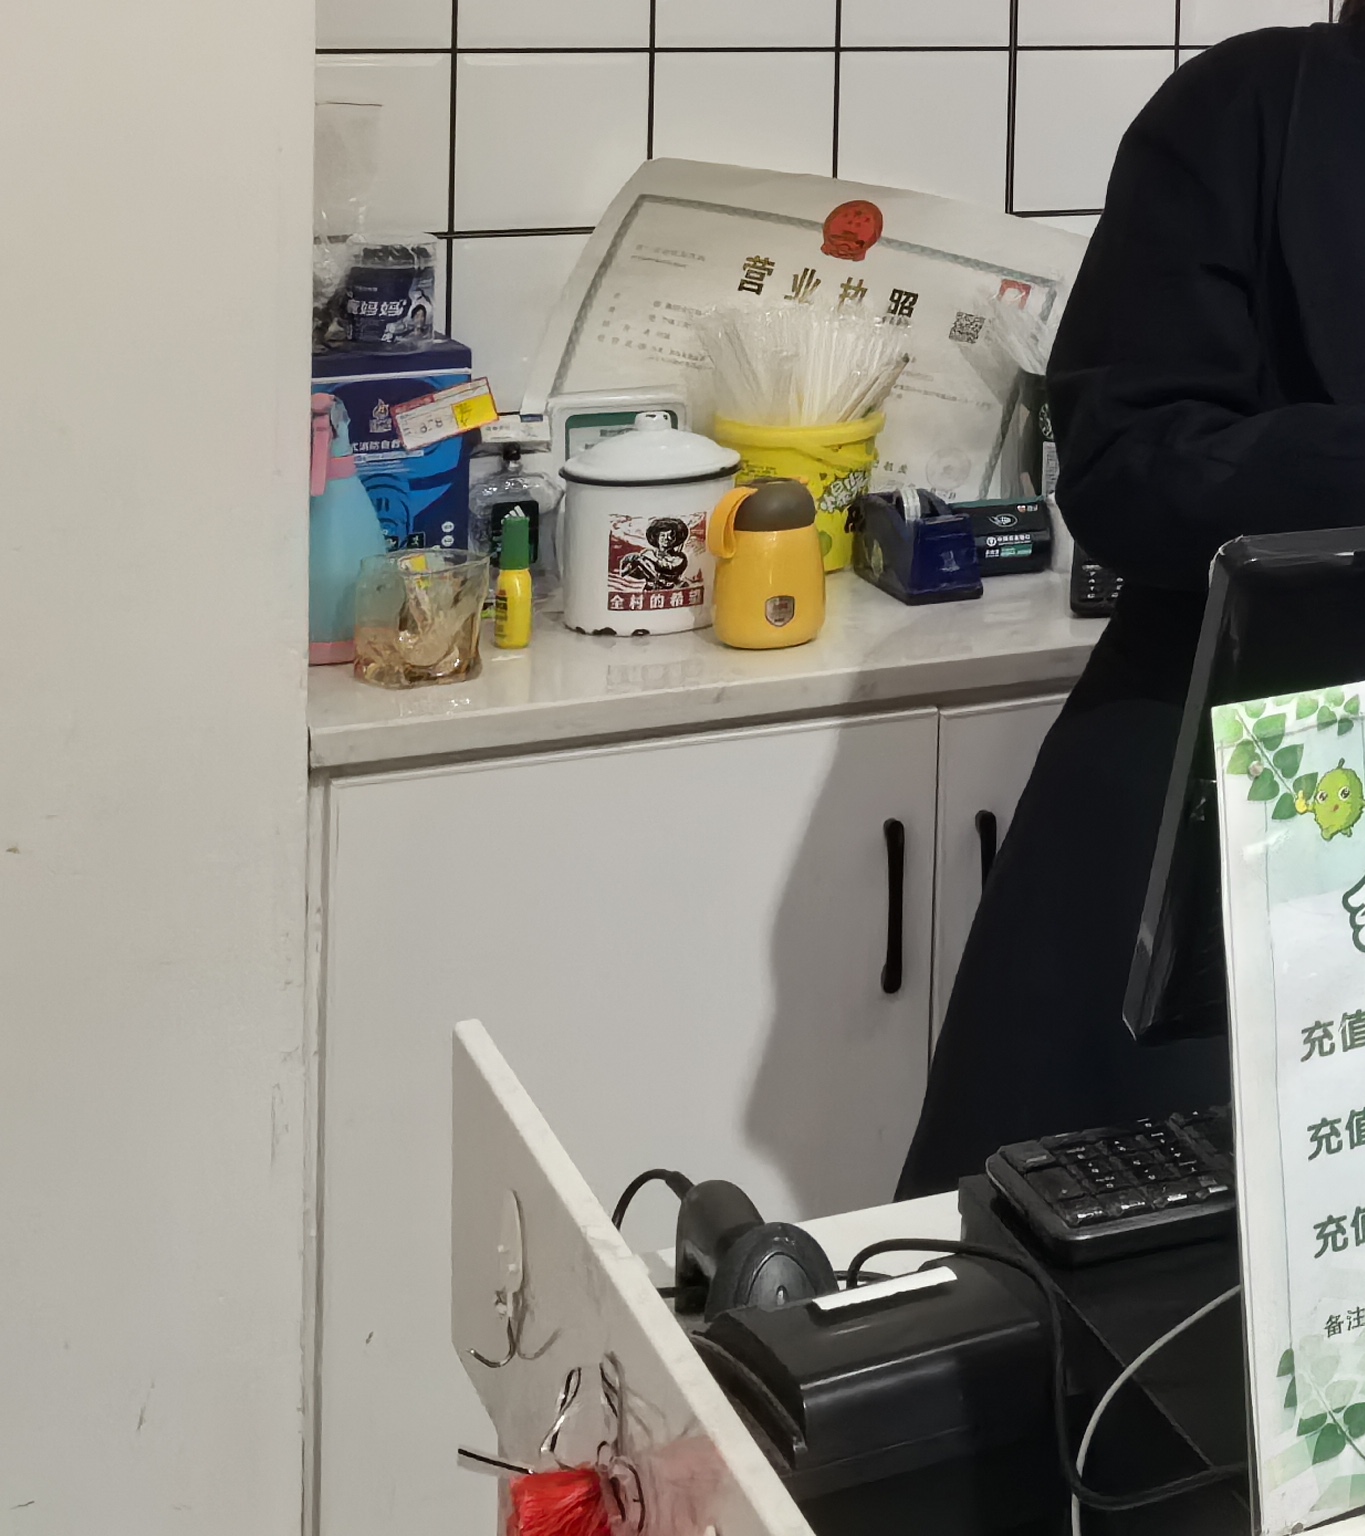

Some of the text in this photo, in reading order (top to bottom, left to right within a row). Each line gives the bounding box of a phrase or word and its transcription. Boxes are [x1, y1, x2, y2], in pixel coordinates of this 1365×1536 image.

[737, 254, 919, 325] 营业执照
[610, 591, 702, 610] 全村的希望
